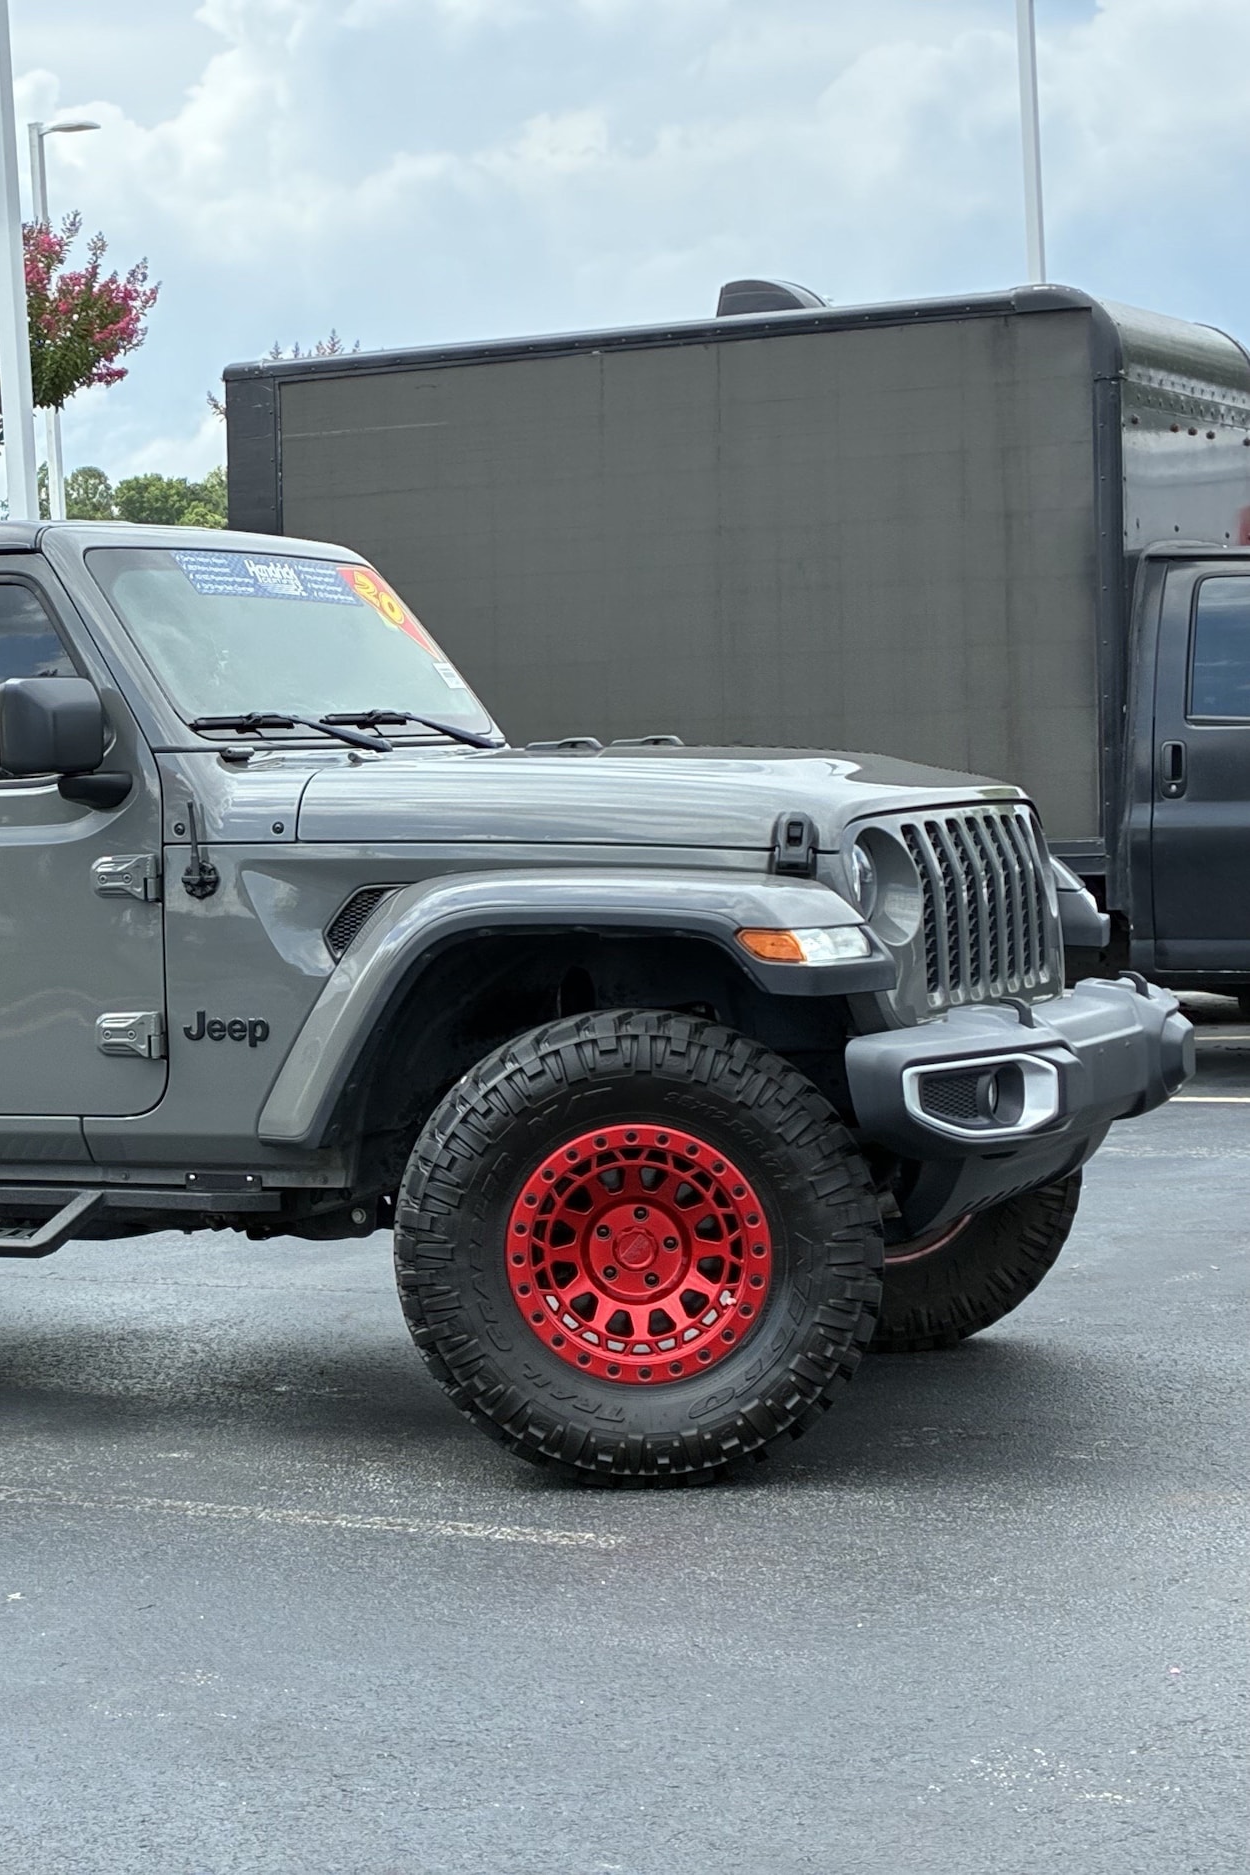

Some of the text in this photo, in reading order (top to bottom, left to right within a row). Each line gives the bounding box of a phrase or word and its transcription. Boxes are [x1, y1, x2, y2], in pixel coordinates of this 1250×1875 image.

[244, 559, 297, 583] Hendrick
[354, 571, 405, 625] 20
[182, 1009, 270, 1048] Jeep
